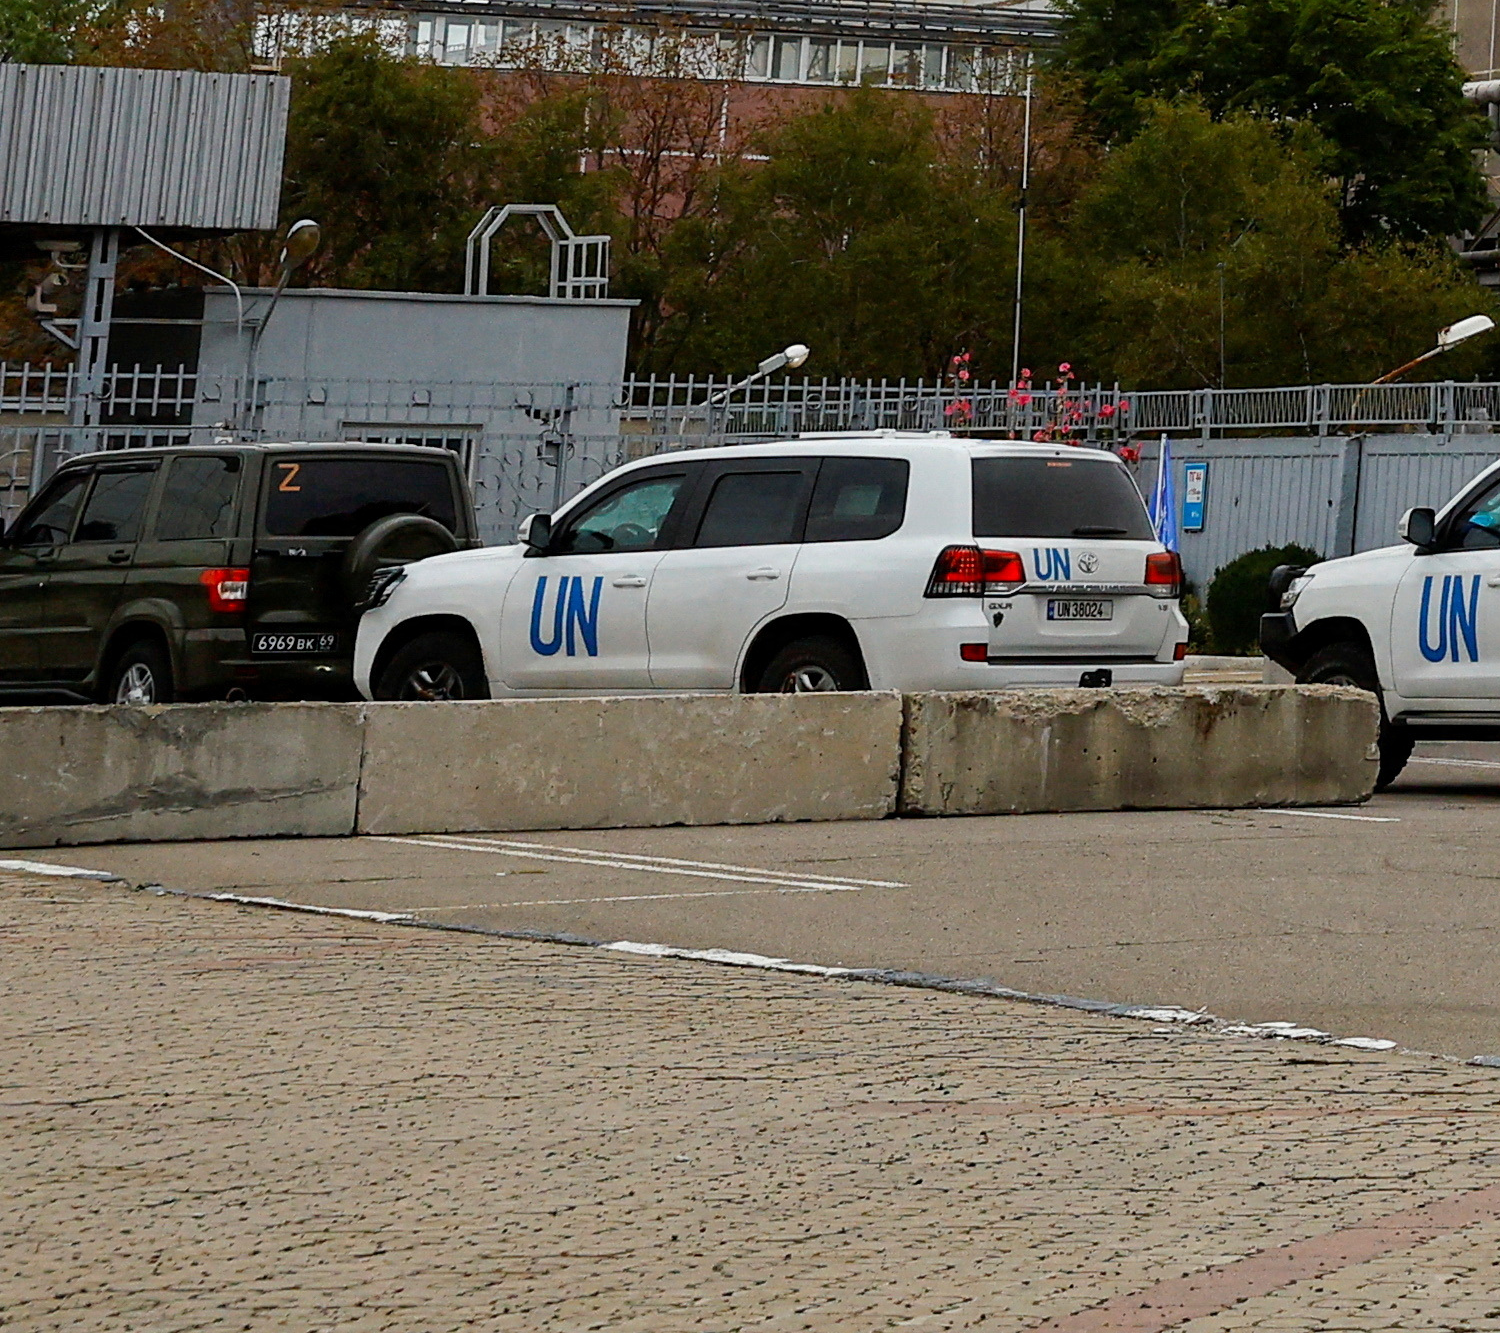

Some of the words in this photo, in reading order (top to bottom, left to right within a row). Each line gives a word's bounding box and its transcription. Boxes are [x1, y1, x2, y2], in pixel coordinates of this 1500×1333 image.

[277, 463, 301, 491] Z
[1033, 548, 1070, 581] UN
[529, 576, 604, 656] UN
[1057, 602, 1071, 617] UN
[1419, 575, 1481, 662] UN
